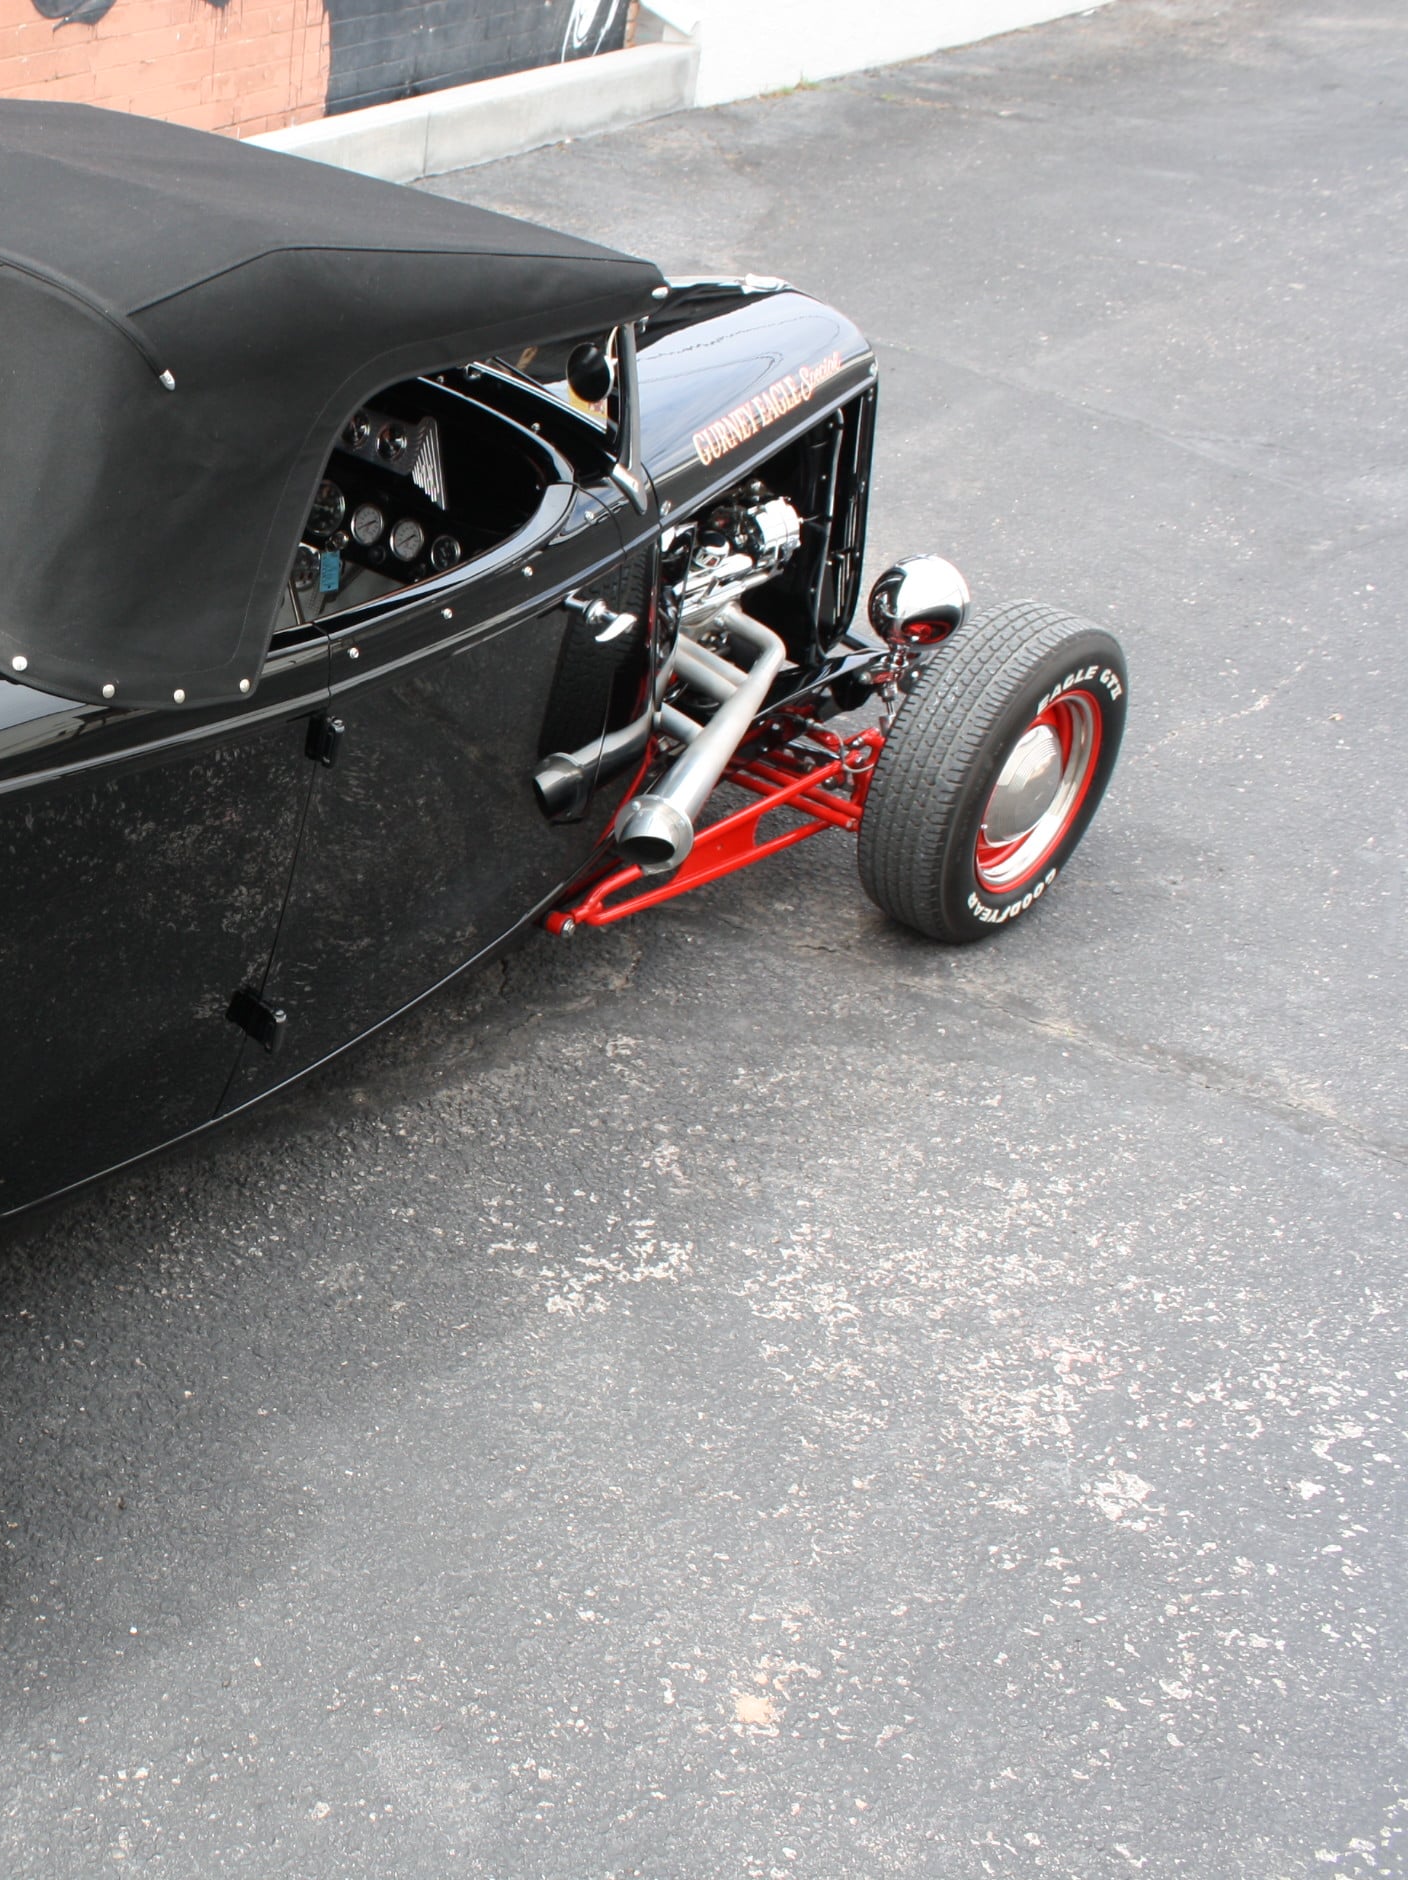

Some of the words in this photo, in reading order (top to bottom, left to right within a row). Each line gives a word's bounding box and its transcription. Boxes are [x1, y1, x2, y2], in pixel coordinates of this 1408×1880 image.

[692, 403, 761, 467] GURNEY
[751, 375, 804, 428] EAGLE
[1036, 664, 1100, 716] EAGLE
[967, 867, 1057, 924] GOODYEAR
